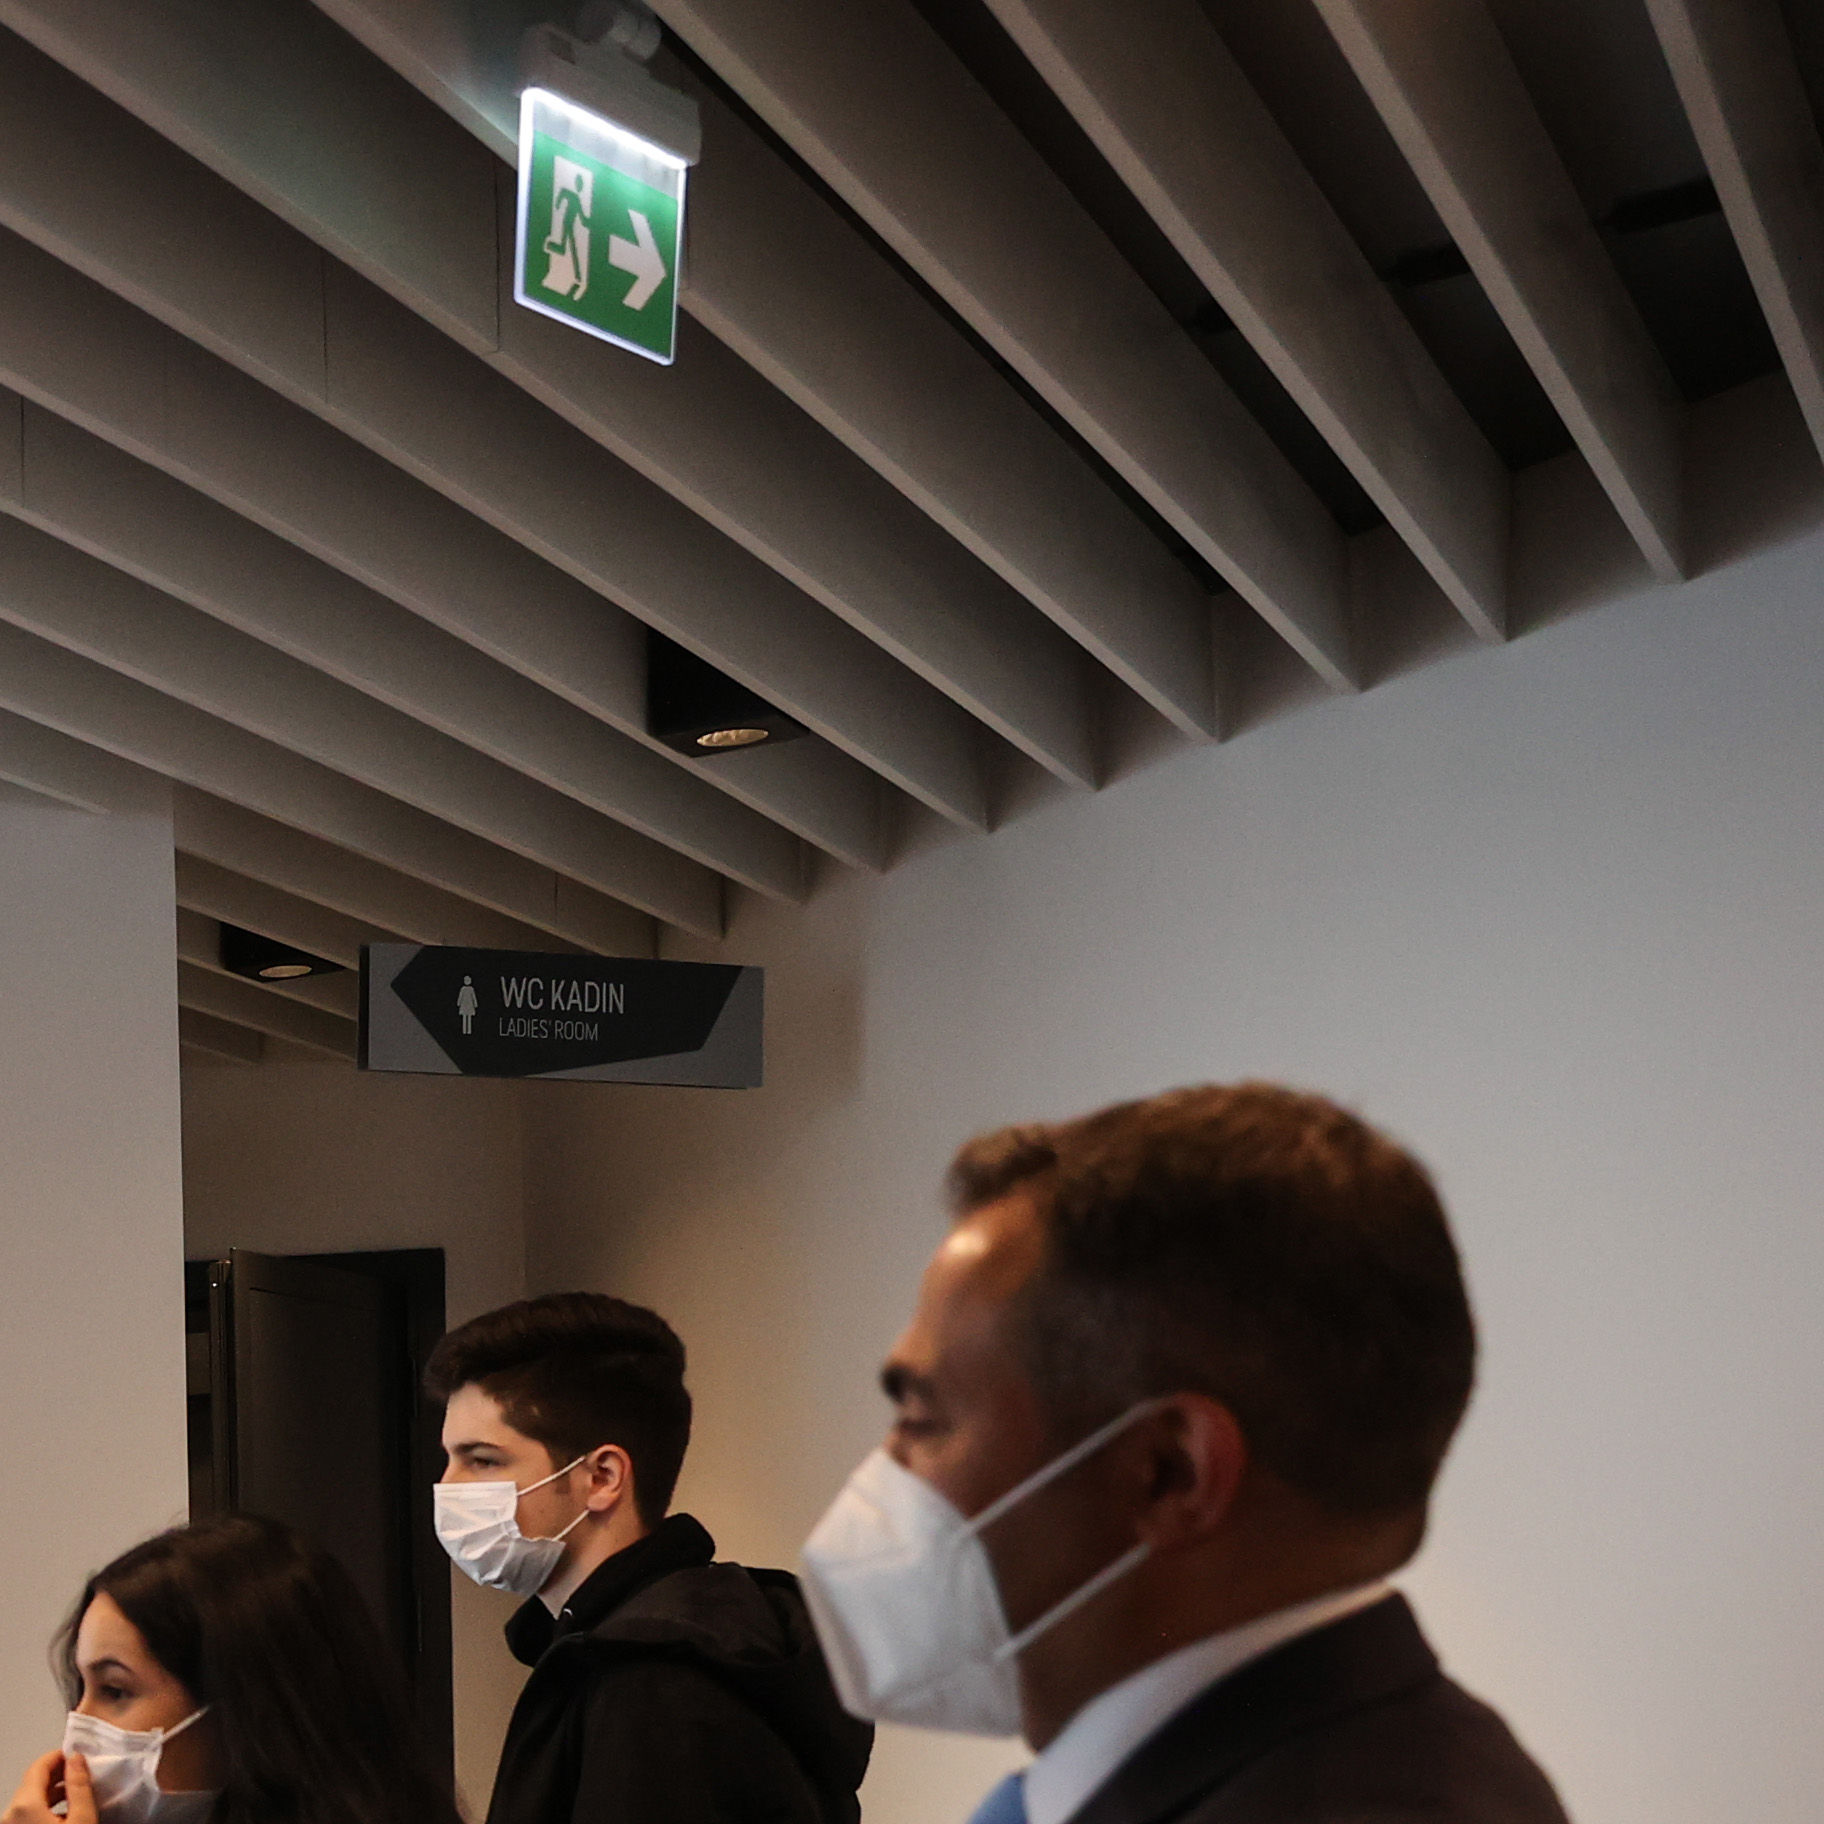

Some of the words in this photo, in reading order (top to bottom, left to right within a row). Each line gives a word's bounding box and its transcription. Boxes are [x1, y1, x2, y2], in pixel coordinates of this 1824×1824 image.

[500, 976, 544, 1009] WC
[551, 979, 624, 1014] KADIN
[554, 1019, 599, 1041] ROOM
